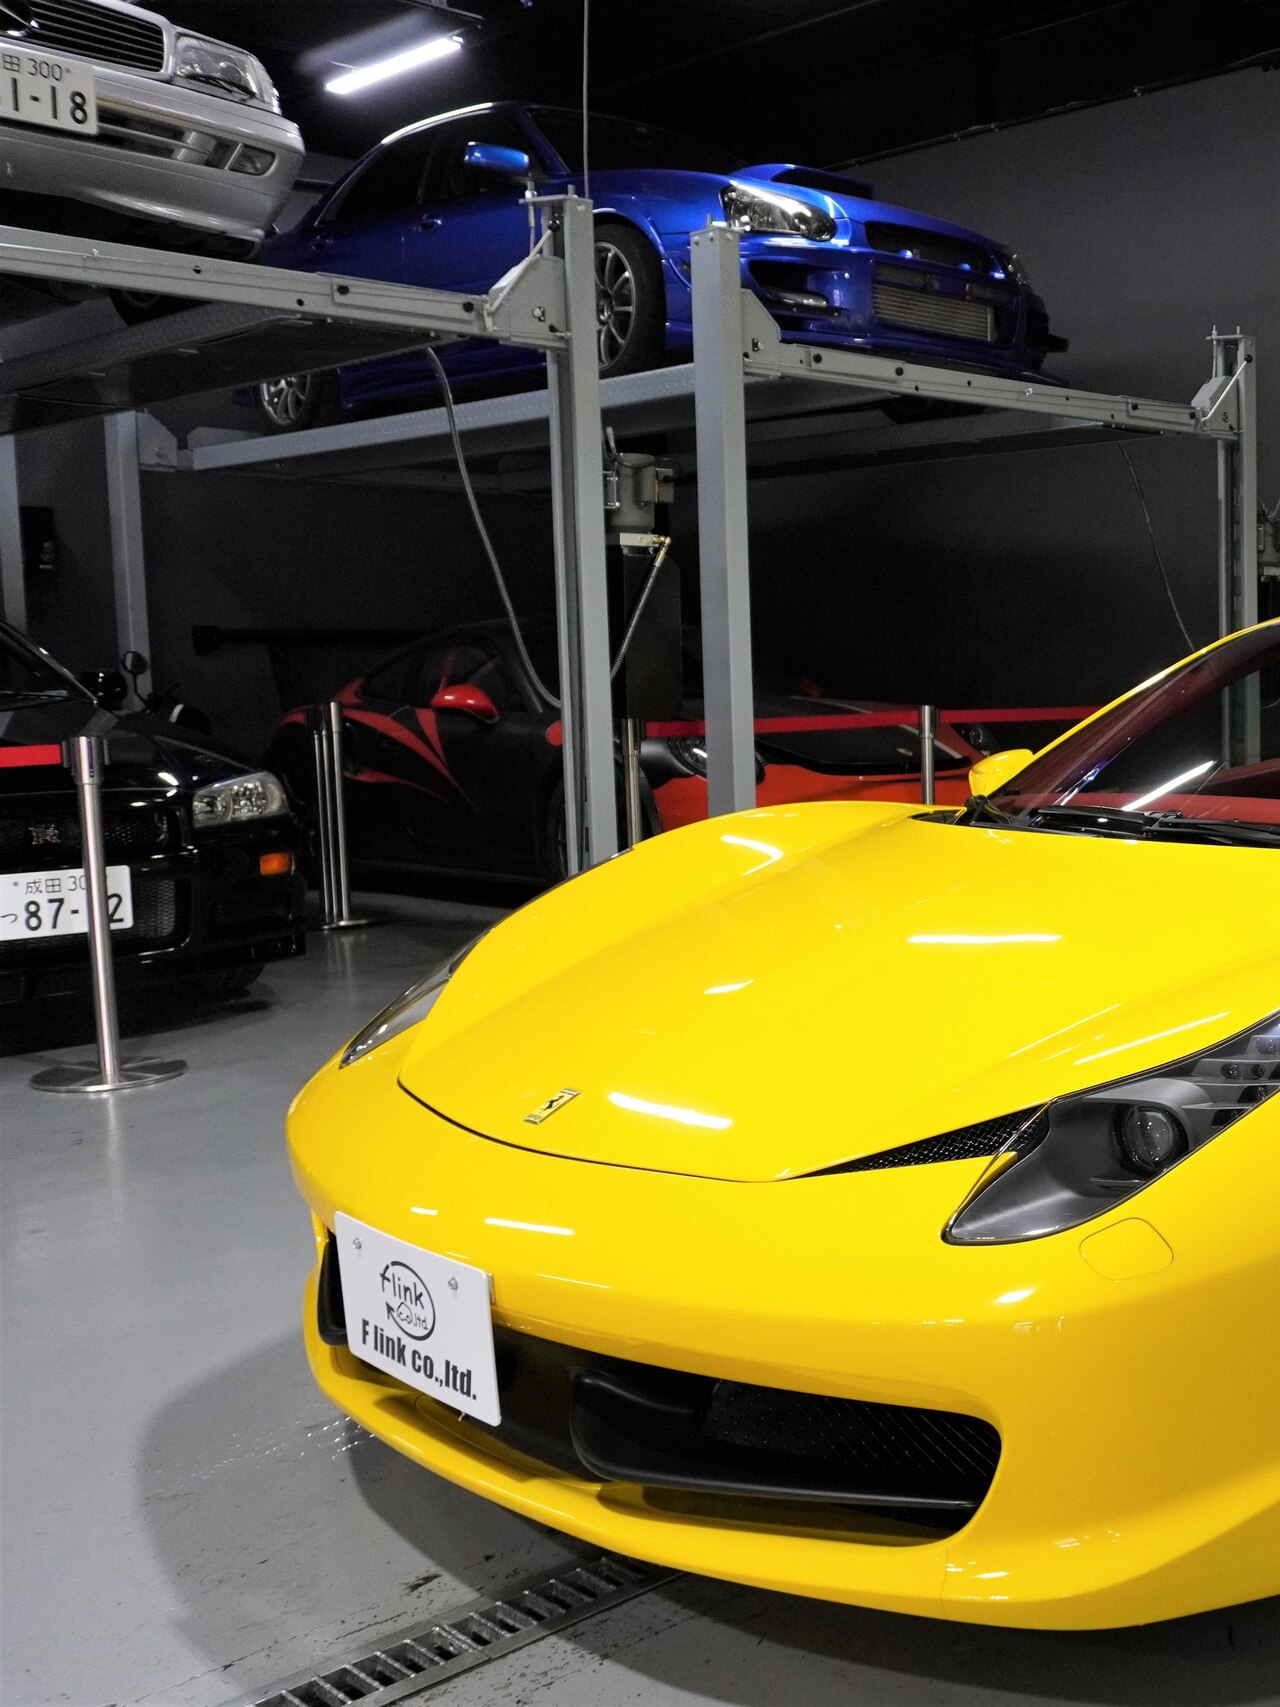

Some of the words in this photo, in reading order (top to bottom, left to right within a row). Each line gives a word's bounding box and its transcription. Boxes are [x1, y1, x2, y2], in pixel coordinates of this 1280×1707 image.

[28, 58, 62, 81] 300
[26, 879, 61, 894] 成田
[67, 875, 86, 891] 30
[24, 893, 124, 931] 87-2
[380, 1264, 425, 1309] flink
[362, 1318, 369, 1345] F
[374, 1325, 407, 1366] link
[411, 1349, 477, 1401] co.,ltd.
